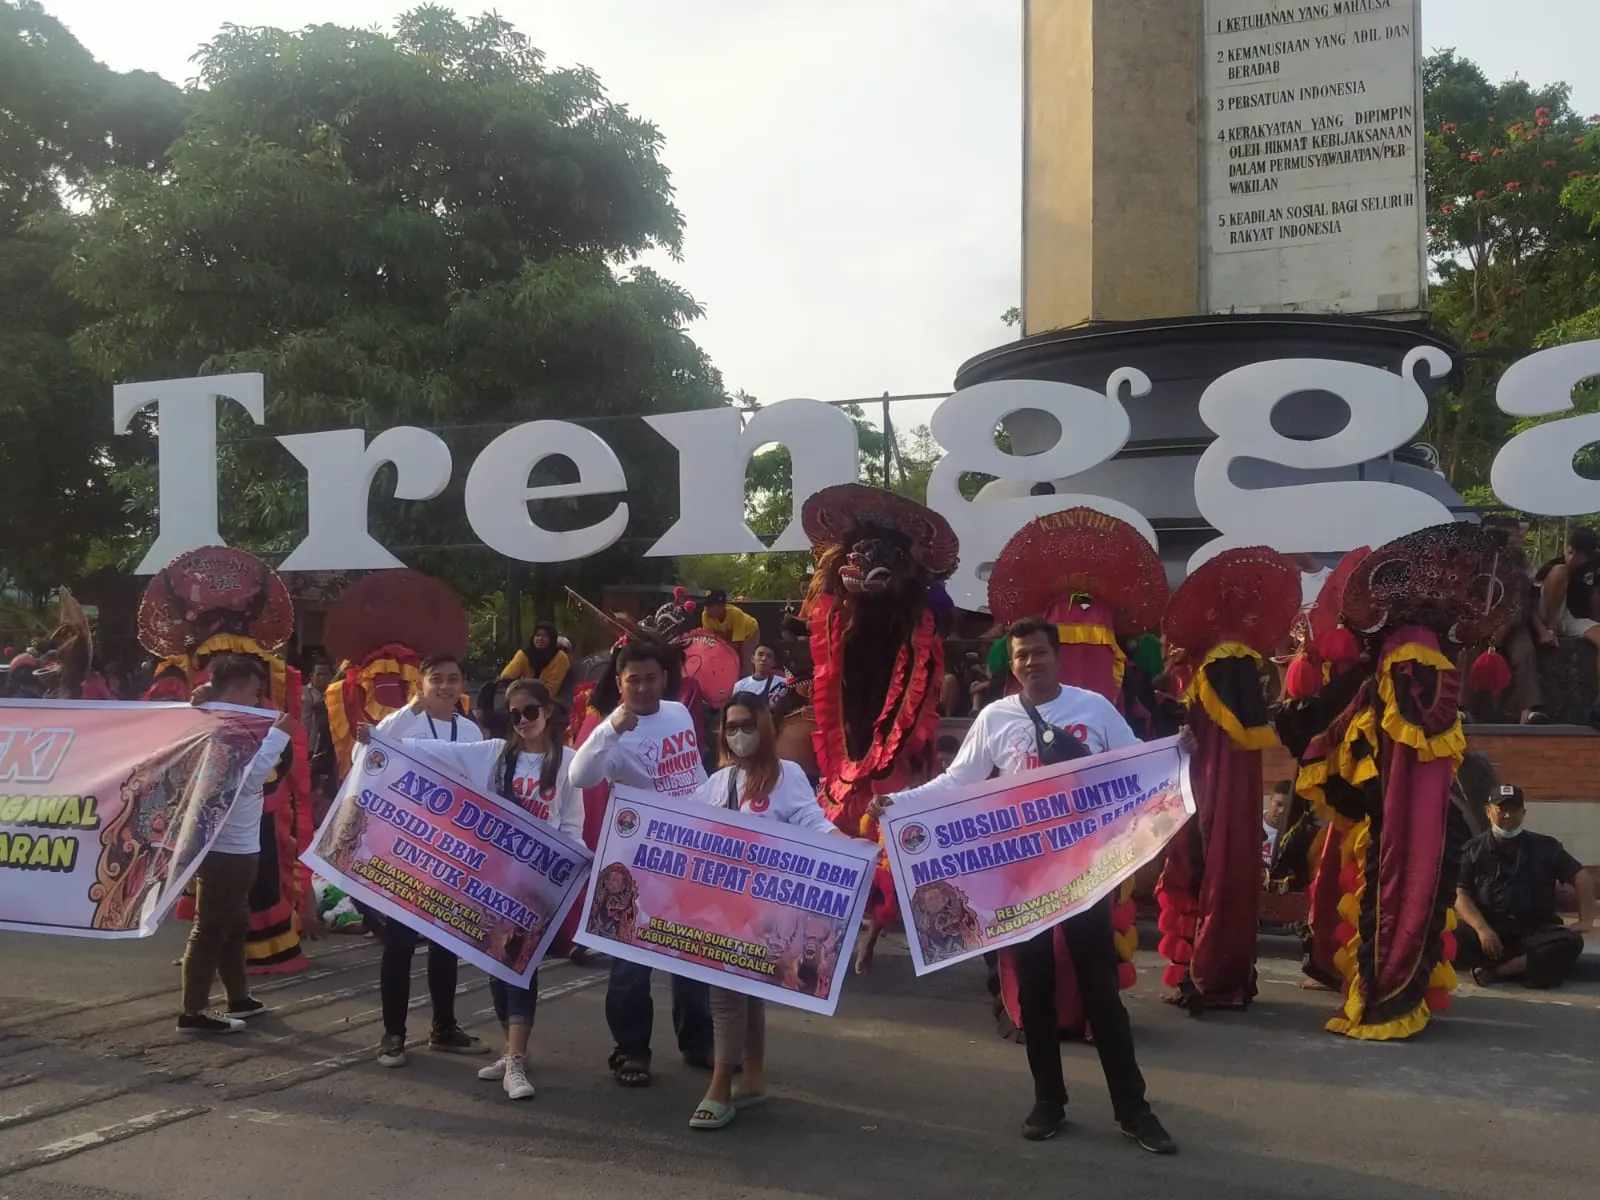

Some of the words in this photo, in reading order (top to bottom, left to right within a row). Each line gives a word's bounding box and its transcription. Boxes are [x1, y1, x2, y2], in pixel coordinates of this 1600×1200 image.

[1226, 10, 1295, 31] KETUHANAN
[1300, 4, 1330, 22] YANG
[1228, 38, 1310, 62] KEMANUSIAAN
[1314, 33, 1346, 48] YANG
[1352, 28, 1382, 44] ADIL
[1385, 24, 1411, 40] DAN
[1228, 60, 1280, 80] BERADAB
[1228, 90, 1295, 111] PERSATUAN
[1300, 80, 1366, 102] INDONESIA
[1228, 120, 1302, 142] KERAKYATAN
[1311, 114, 1344, 131] YANG
[1355, 105, 1412, 125] DIPIMPIN
[1229, 141, 1260, 159] OLEH
[1265, 136, 1308, 154] HIKMAT
[1312, 124, 1412, 149] KEBIJAKSANAAN
[1229, 158, 1266, 178] DALAM
[1229, 177, 1279, 195] WAKILAN
[1230, 208, 1284, 226] KEADILAN
[1286, 202, 1329, 220] SOSIAL
[1331, 198, 1358, 215] BAGI
[1360, 193, 1414, 211] SELURUH
[1230, 227, 1275, 245] RAKYAT
[1279, 220, 1342, 239] INDONESIA
[662, 729, 696, 759] AYO
[0, 795, 98, 829] GAWAL
[387, 769, 454, 817] AYO
[453, 799, 575, 887] DUKUNG
[934, 811, 1020, 849] SUBSIDI
[1023, 796, 1071, 827] BBM
[1071, 773, 1143, 813] UNTUK
[356, 788, 440, 842] SUBSIDI
[436, 832, 487, 871] BBM
[646, 819, 747, 861] PENYALURAN
[746, 842, 816, 876] SUBSIDI
[816, 861, 859, 890] BBM
[910, 831, 1046, 887] MASYARAKAT
[1046, 815, 1099, 852] YANG
[369, 856, 423, 891] RELAWAN
[391, 837, 467, 890] UNTUK
[462, 875, 540, 932] RAKYAT
[632, 843, 688, 879] AGAR
[689, 855, 751, 894] TEPAT
[750, 872, 850, 920] SASARAN
[352, 861, 416, 903] KABUPATEN
[416, 894, 487, 942] TRENGGALEK
[995, 889, 1060, 922] RELAWAN
[649, 918, 704, 943] RELAWAN
[985, 901, 1062, 939] KABUPATEN
[636, 927, 701, 954] KABUPATEN
[700, 942, 777, 976] TRENGGALEK
